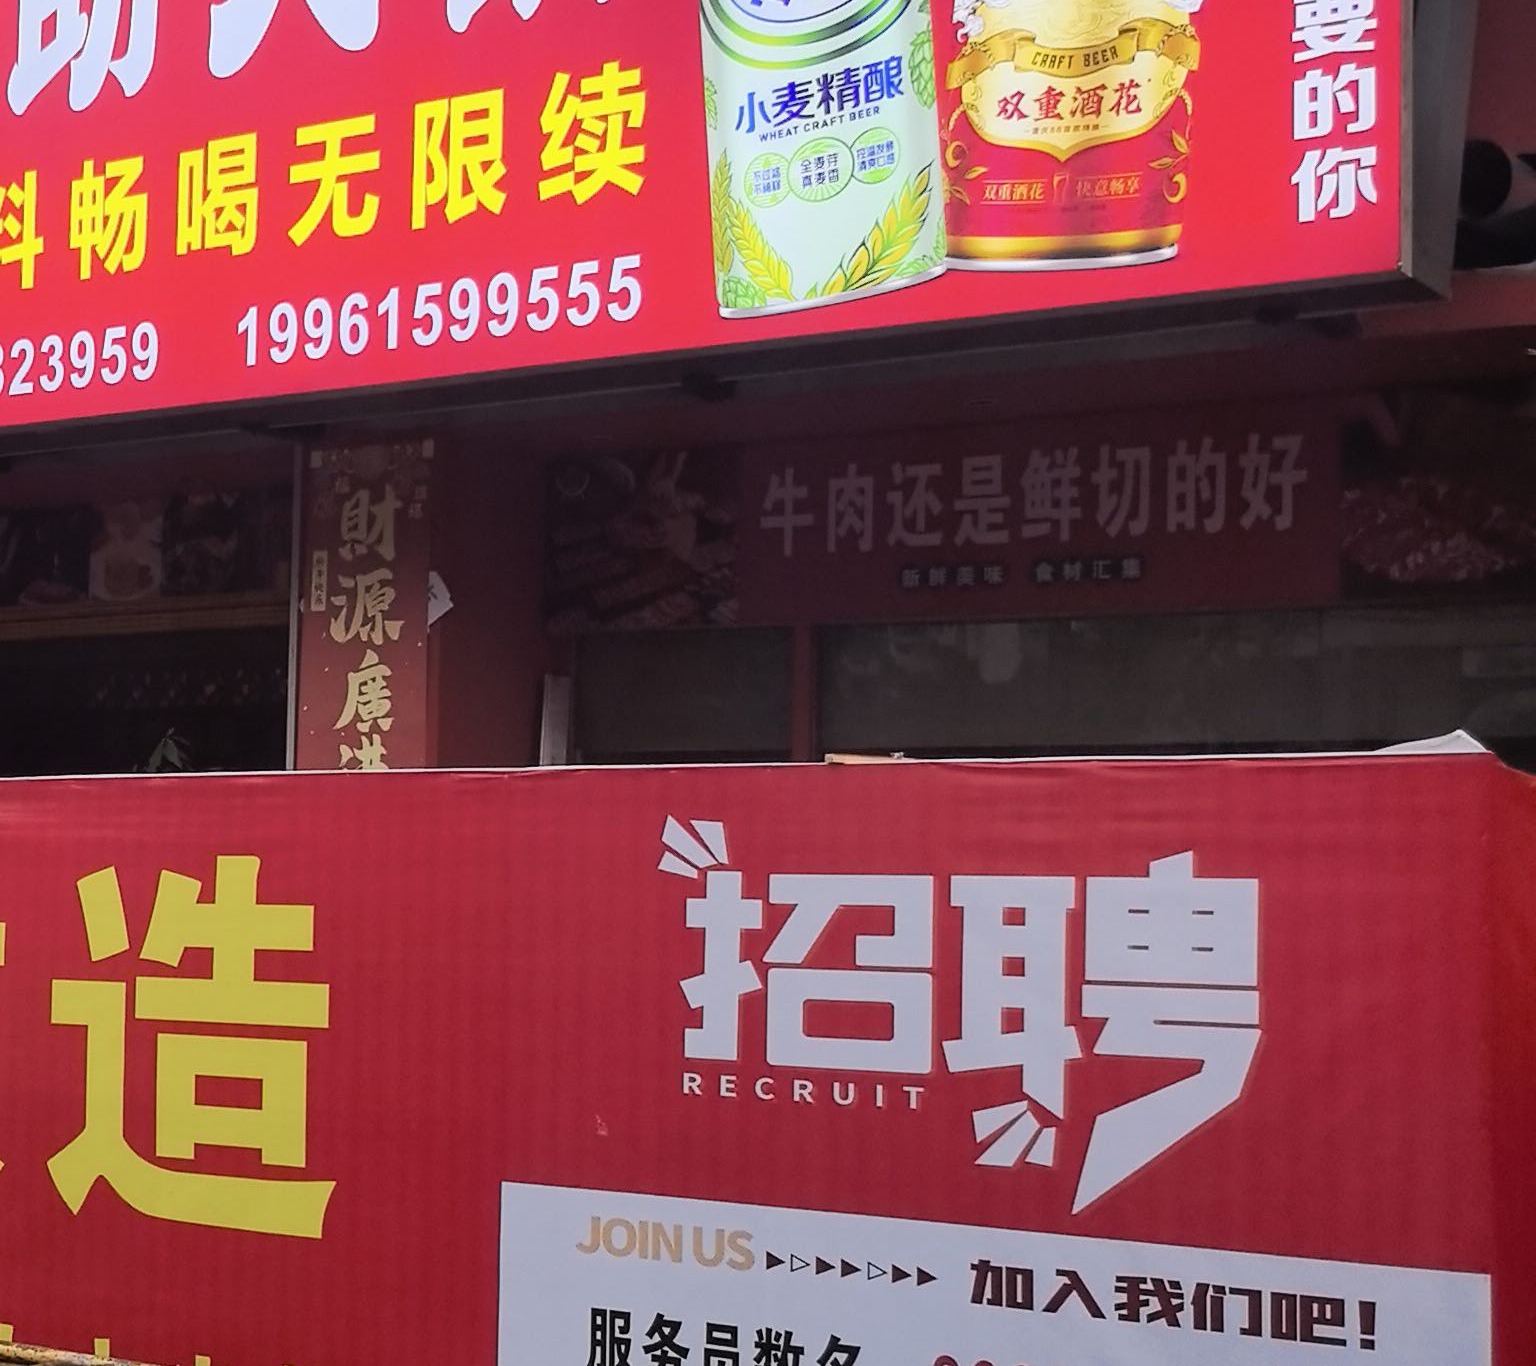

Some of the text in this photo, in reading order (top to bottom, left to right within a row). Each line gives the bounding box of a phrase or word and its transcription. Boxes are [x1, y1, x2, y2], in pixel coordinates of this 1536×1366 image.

[1031, 45, 1119, 68] CRAFT BEER
[735, 55, 904, 134] 小麦精酿
[759, 105, 881, 143] WHEAT CRAFT BEER
[996, 78, 1143, 122] 双重酒花
[235, 255, 643, 368] 19961599555
[759, 431, 1307, 559] 牛肉还是鲜切的好
[678, 850, 1262, 1216] 招聘
[681, 1071, 927, 1111] RECRUIT
[575, 1214, 755, 1272] JOIN US
[969, 1257, 1377, 1351] 加入我们吧！
